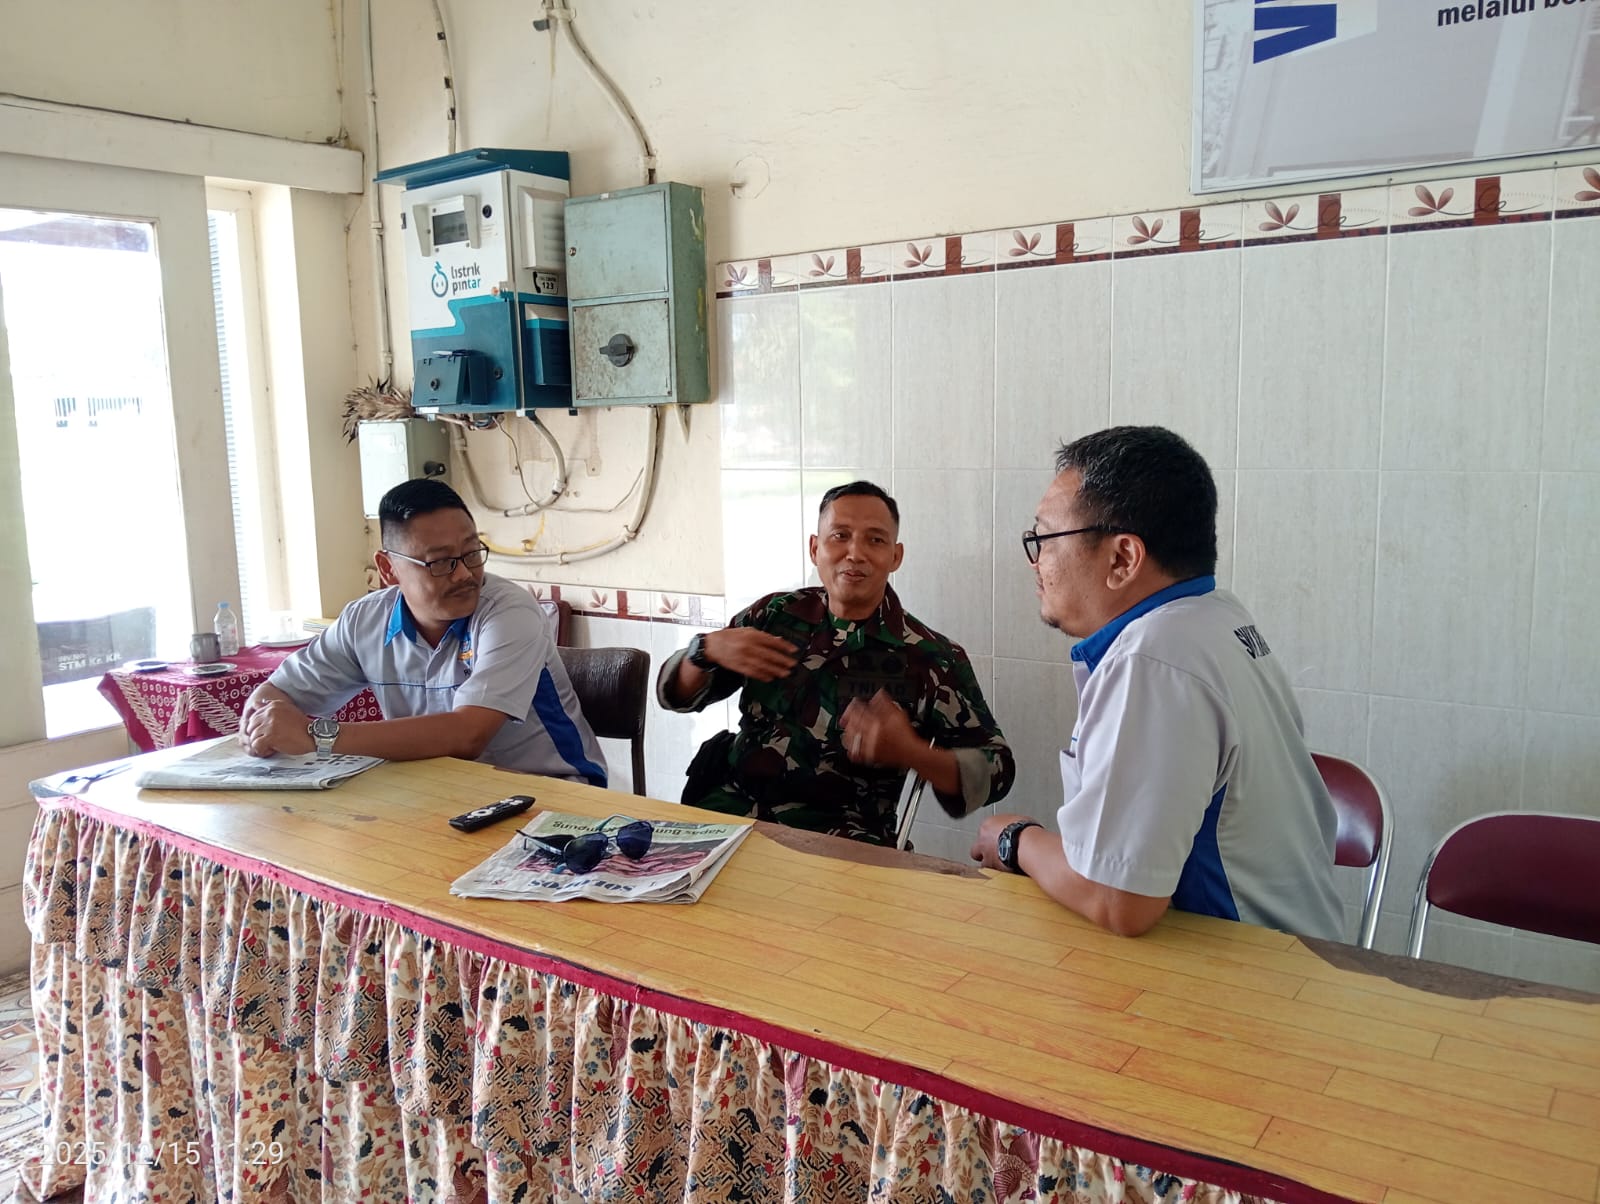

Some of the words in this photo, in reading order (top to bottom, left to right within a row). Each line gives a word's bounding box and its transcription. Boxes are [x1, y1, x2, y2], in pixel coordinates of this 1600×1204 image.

[1437, 0, 1535, 27] melalui
[451, 262, 481, 278] listrik
[452, 278, 481, 295] pintar
[57, 659, 86, 671] STM
